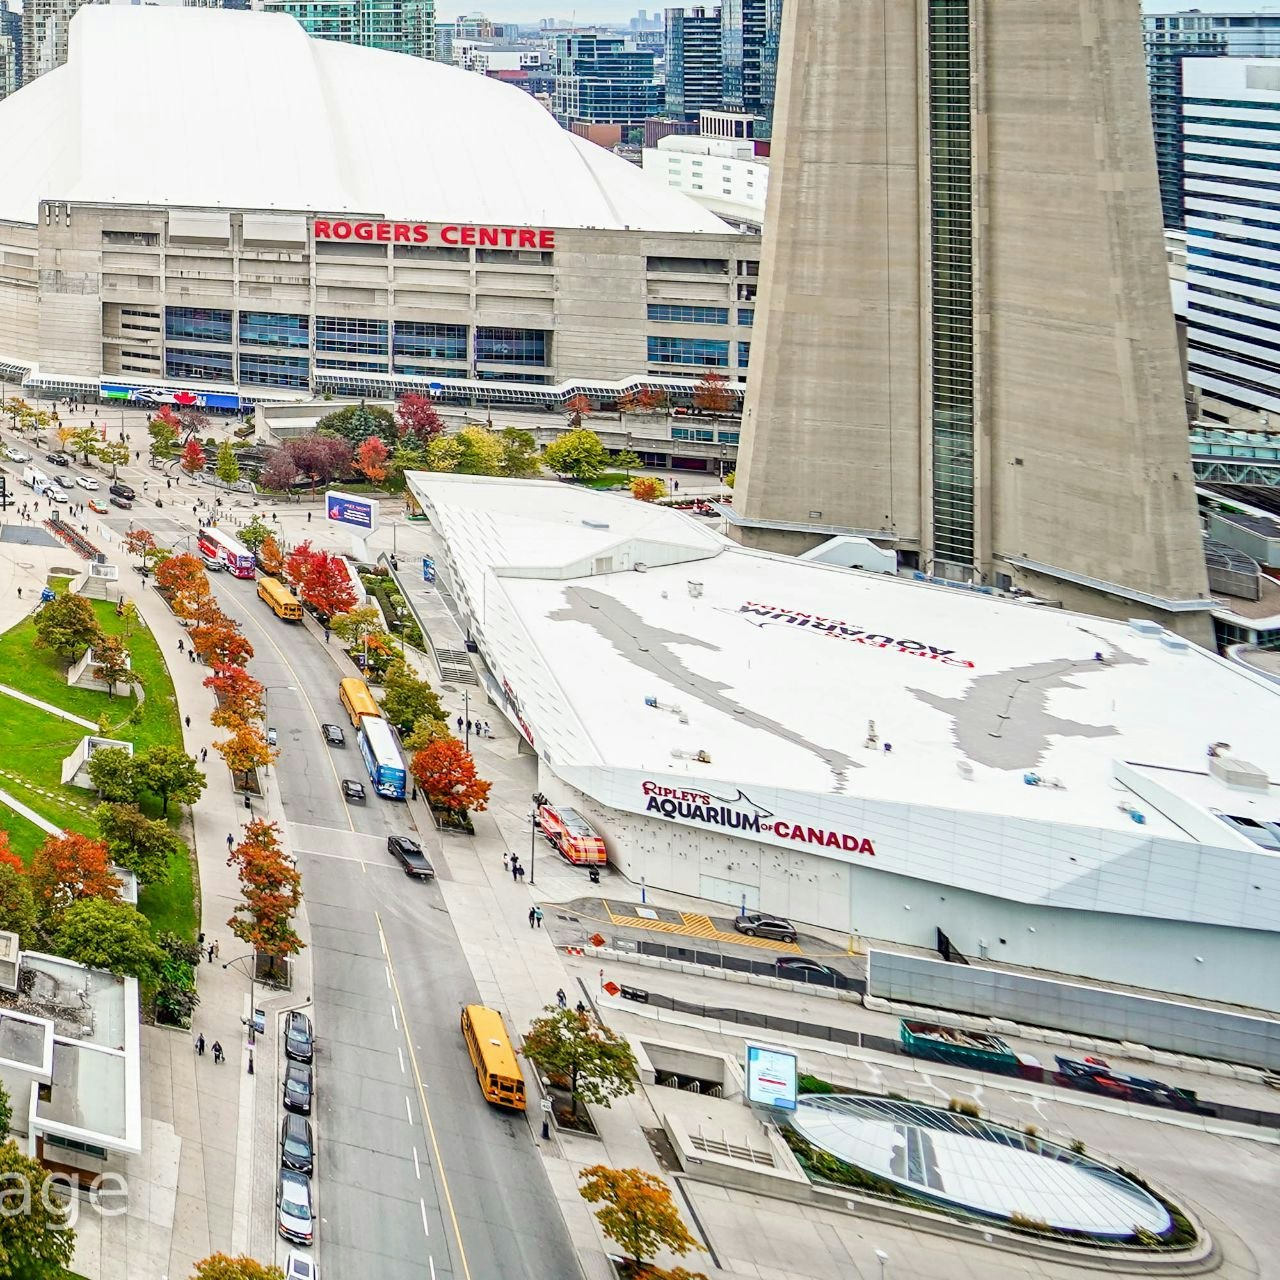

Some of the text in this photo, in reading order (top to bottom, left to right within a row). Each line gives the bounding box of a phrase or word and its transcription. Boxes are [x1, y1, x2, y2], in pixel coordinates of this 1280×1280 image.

[315, 221, 556, 249] ROGERS CENTRE
[745, 601, 847, 626] CANADA
[738, 605, 956, 655] AQUARIUM
[642, 781, 711, 805] RIPLEY'S
[646, 795, 876, 856] AQUARIUM OF CANADA
